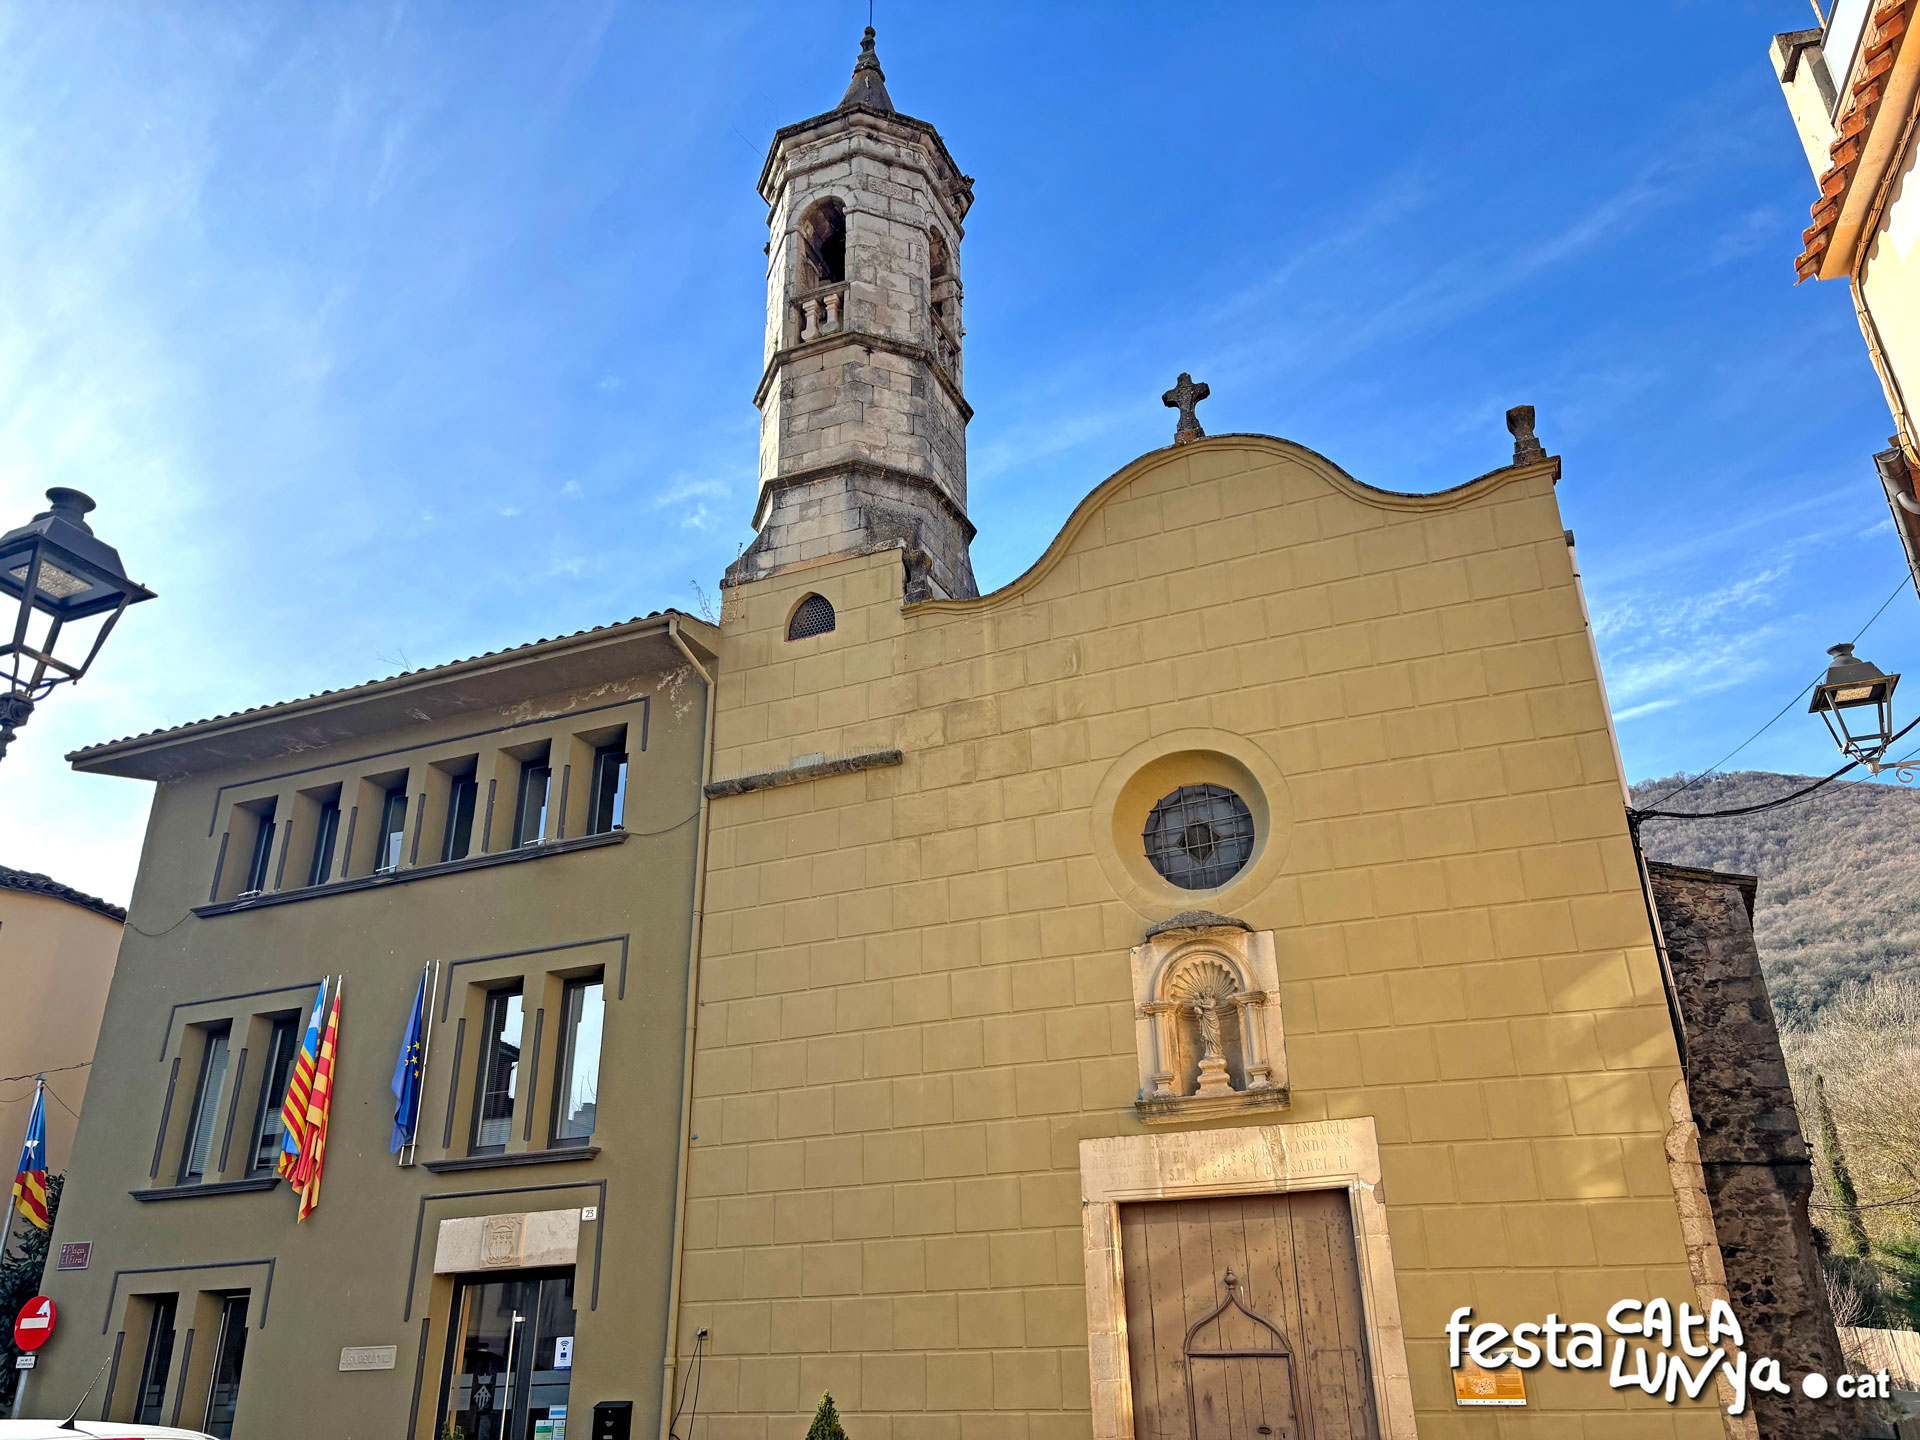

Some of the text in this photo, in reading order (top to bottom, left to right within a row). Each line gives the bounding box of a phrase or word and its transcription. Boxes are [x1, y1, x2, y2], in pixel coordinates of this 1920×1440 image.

[1295, 1121, 1349, 1137] ROSARIO
[585, 1209, 594, 1218] 23
[66, 1244, 85, 1255] Plaça
